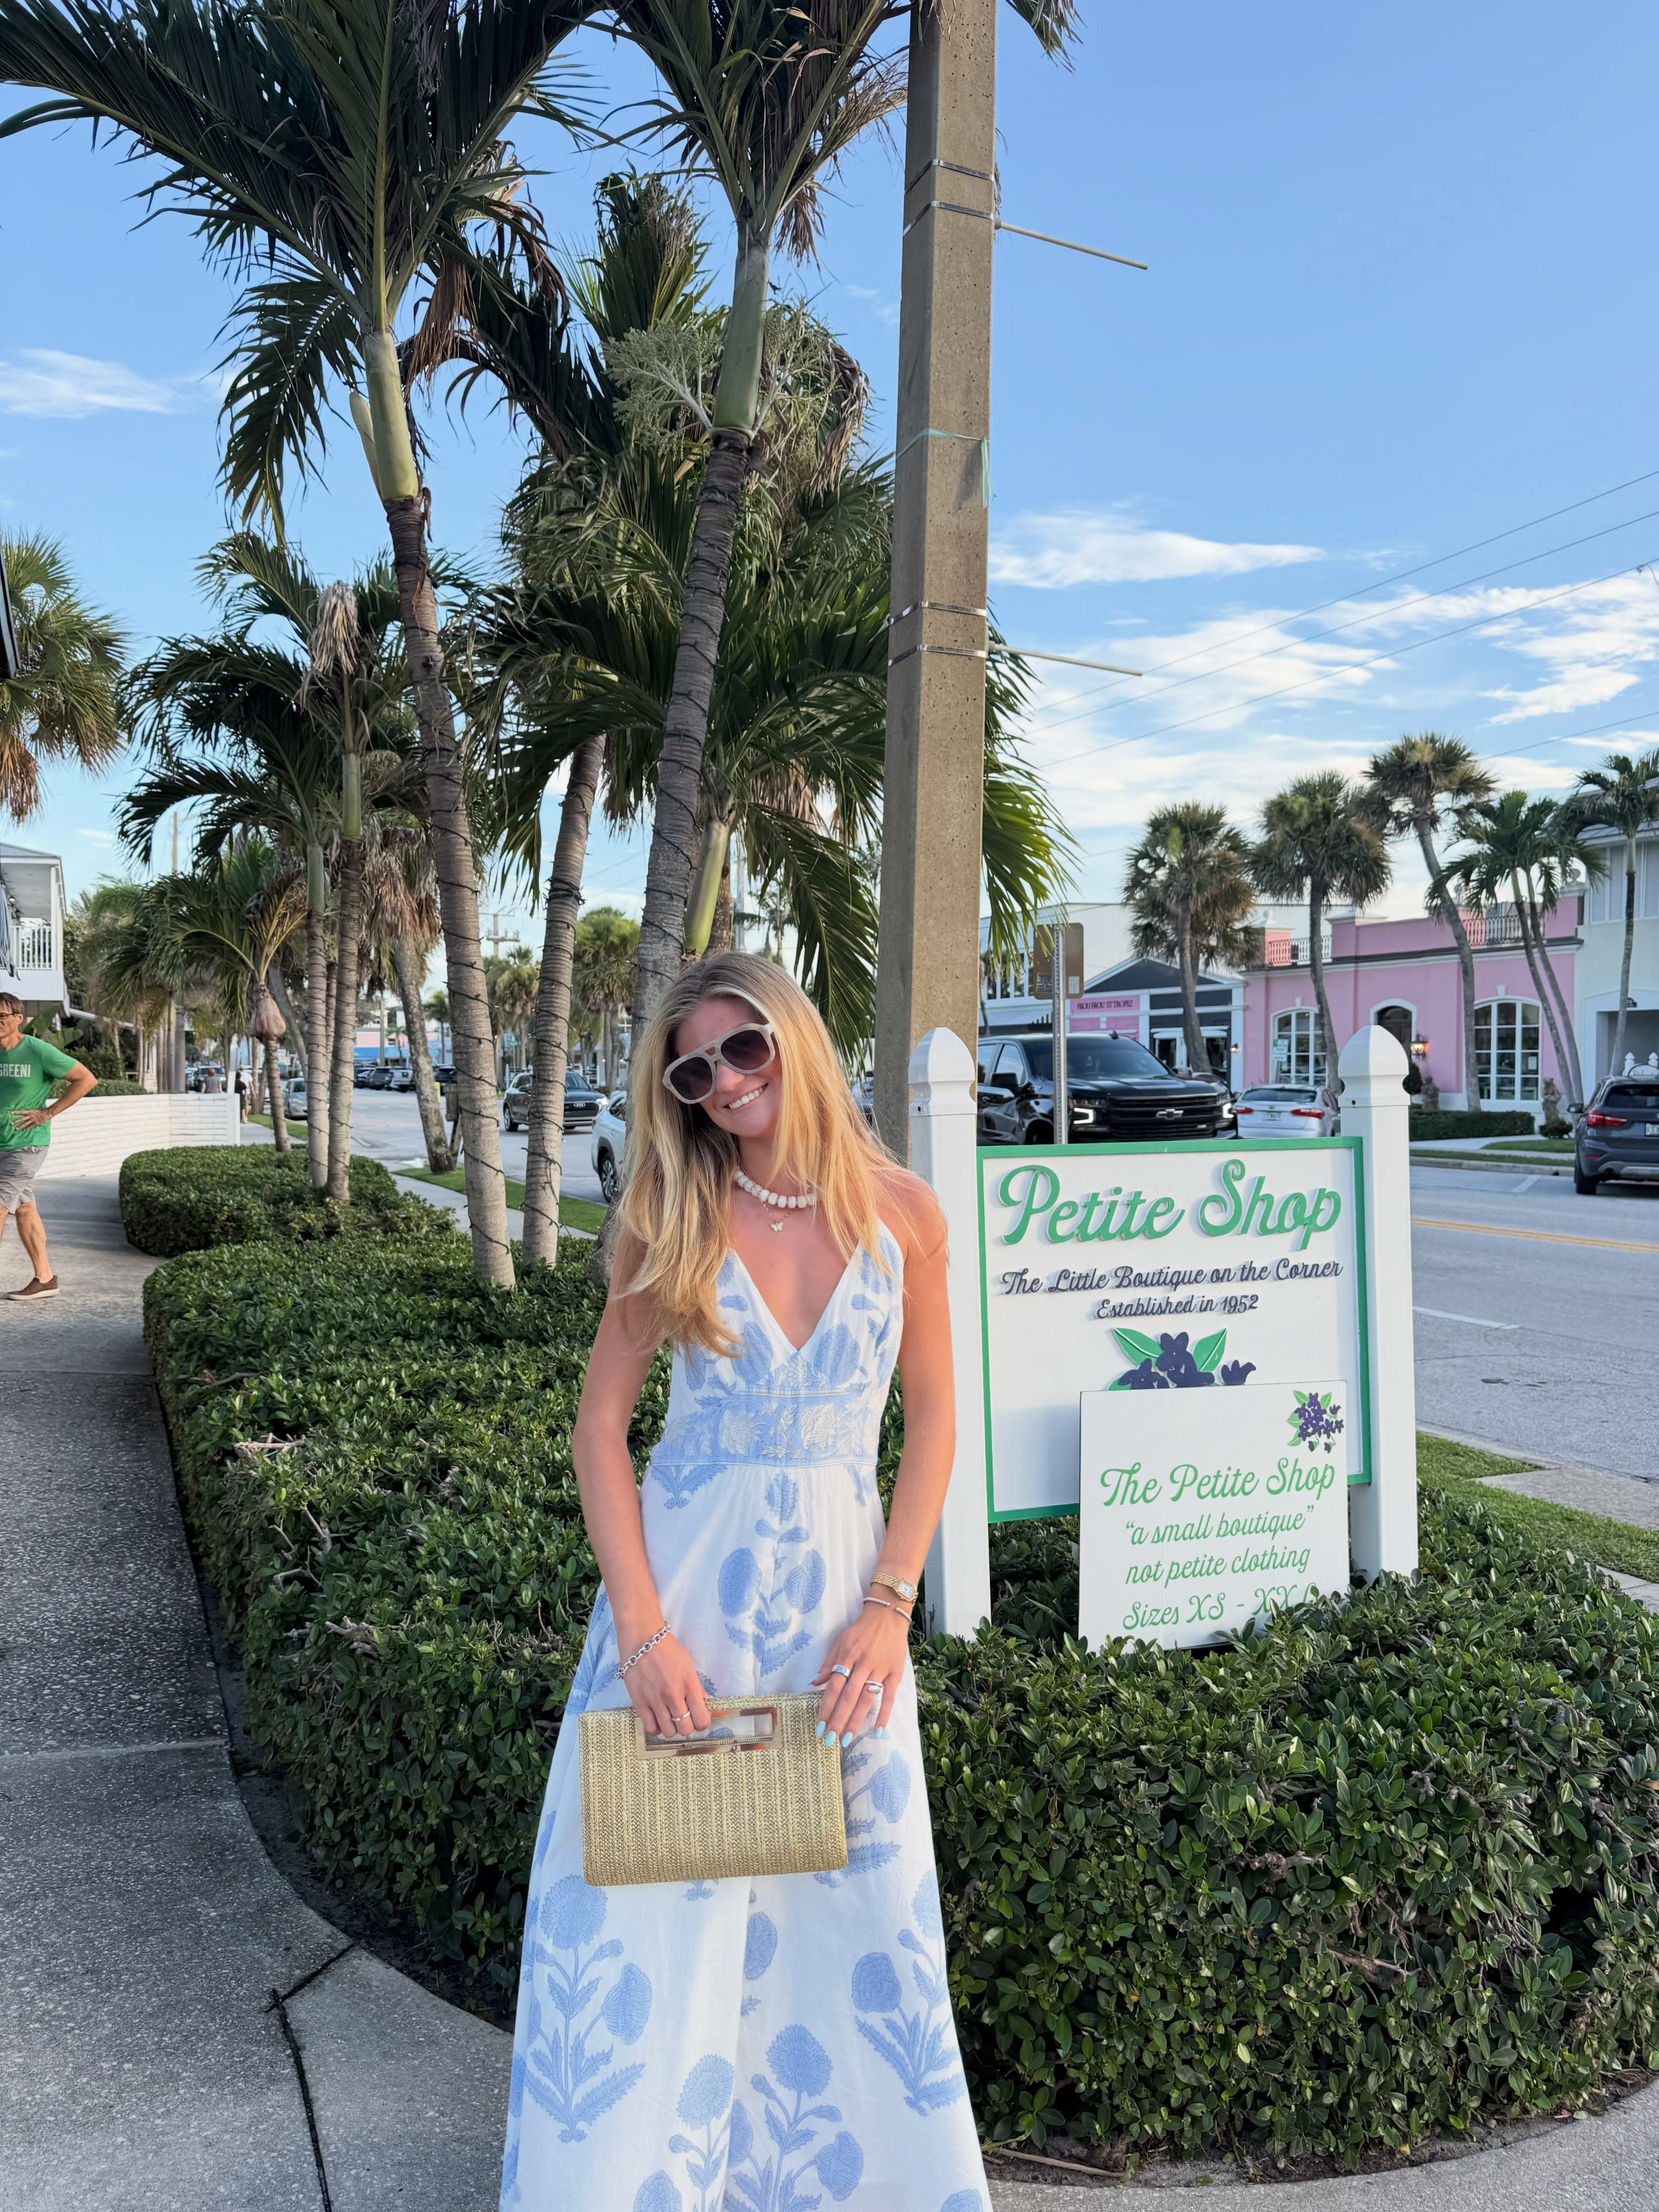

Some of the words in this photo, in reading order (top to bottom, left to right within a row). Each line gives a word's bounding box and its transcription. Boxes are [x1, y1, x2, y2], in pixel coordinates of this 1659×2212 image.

[999, 1164, 1185, 1245] Petite
[1198, 1158, 1342, 1251] Shop
[1001, 1267, 1043, 1294] The
[1048, 1267, 1110, 1293] Little
[1114, 1265, 1207, 1292] Boutique
[1210, 1267, 1236, 1283] on
[1239, 1260, 1272, 1282] the
[1275, 1257, 1344, 1280] Corner
[1096, 1294, 1196, 1319] Established
[1198, 1295, 1217, 1313] in
[1222, 1294, 1259, 1314] 1952
[1100, 1461, 1163, 1507] The
[1169, 1464, 1260, 1502] Petite
[1265, 1456, 1336, 1501] Shop
[1150, 1514, 1213, 1544] small
[1125, 1560, 1164, 1584] not
[1164, 1553, 1228, 1588] petite
[1231, 1545, 1311, 1574] clothing
[1123, 1601, 1179, 1630] Sizes
[1185, 1592, 1226, 1624] XS
